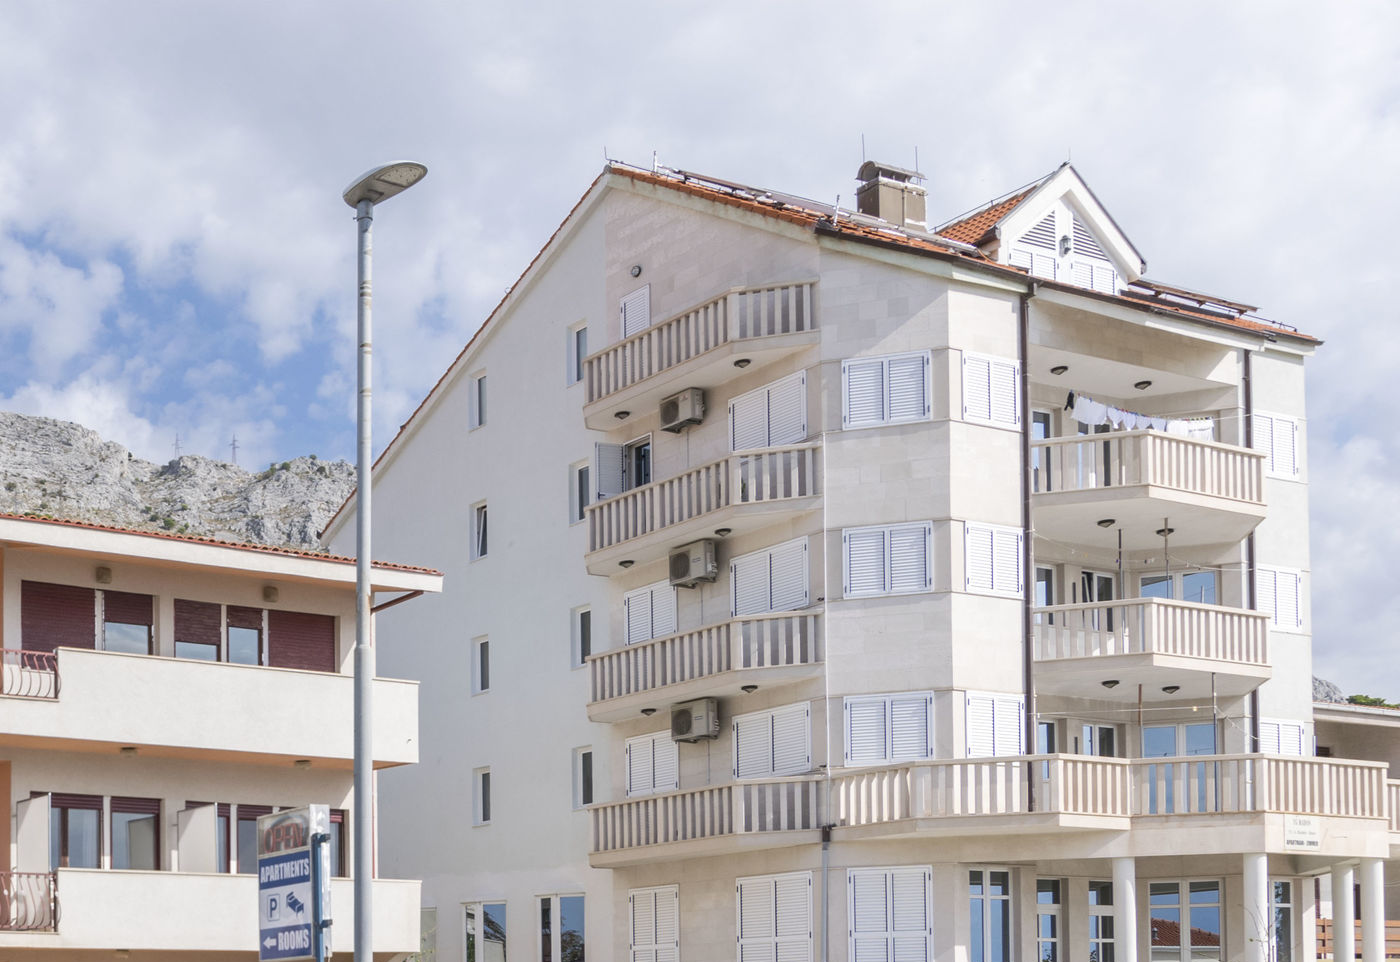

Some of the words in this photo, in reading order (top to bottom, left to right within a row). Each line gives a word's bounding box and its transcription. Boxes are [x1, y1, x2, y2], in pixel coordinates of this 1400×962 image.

[264, 822, 303, 853] OPEN
[260, 858, 309, 883] APARTMENTS
[270, 897, 277, 918] P
[278, 929, 310, 951] ROOMS
